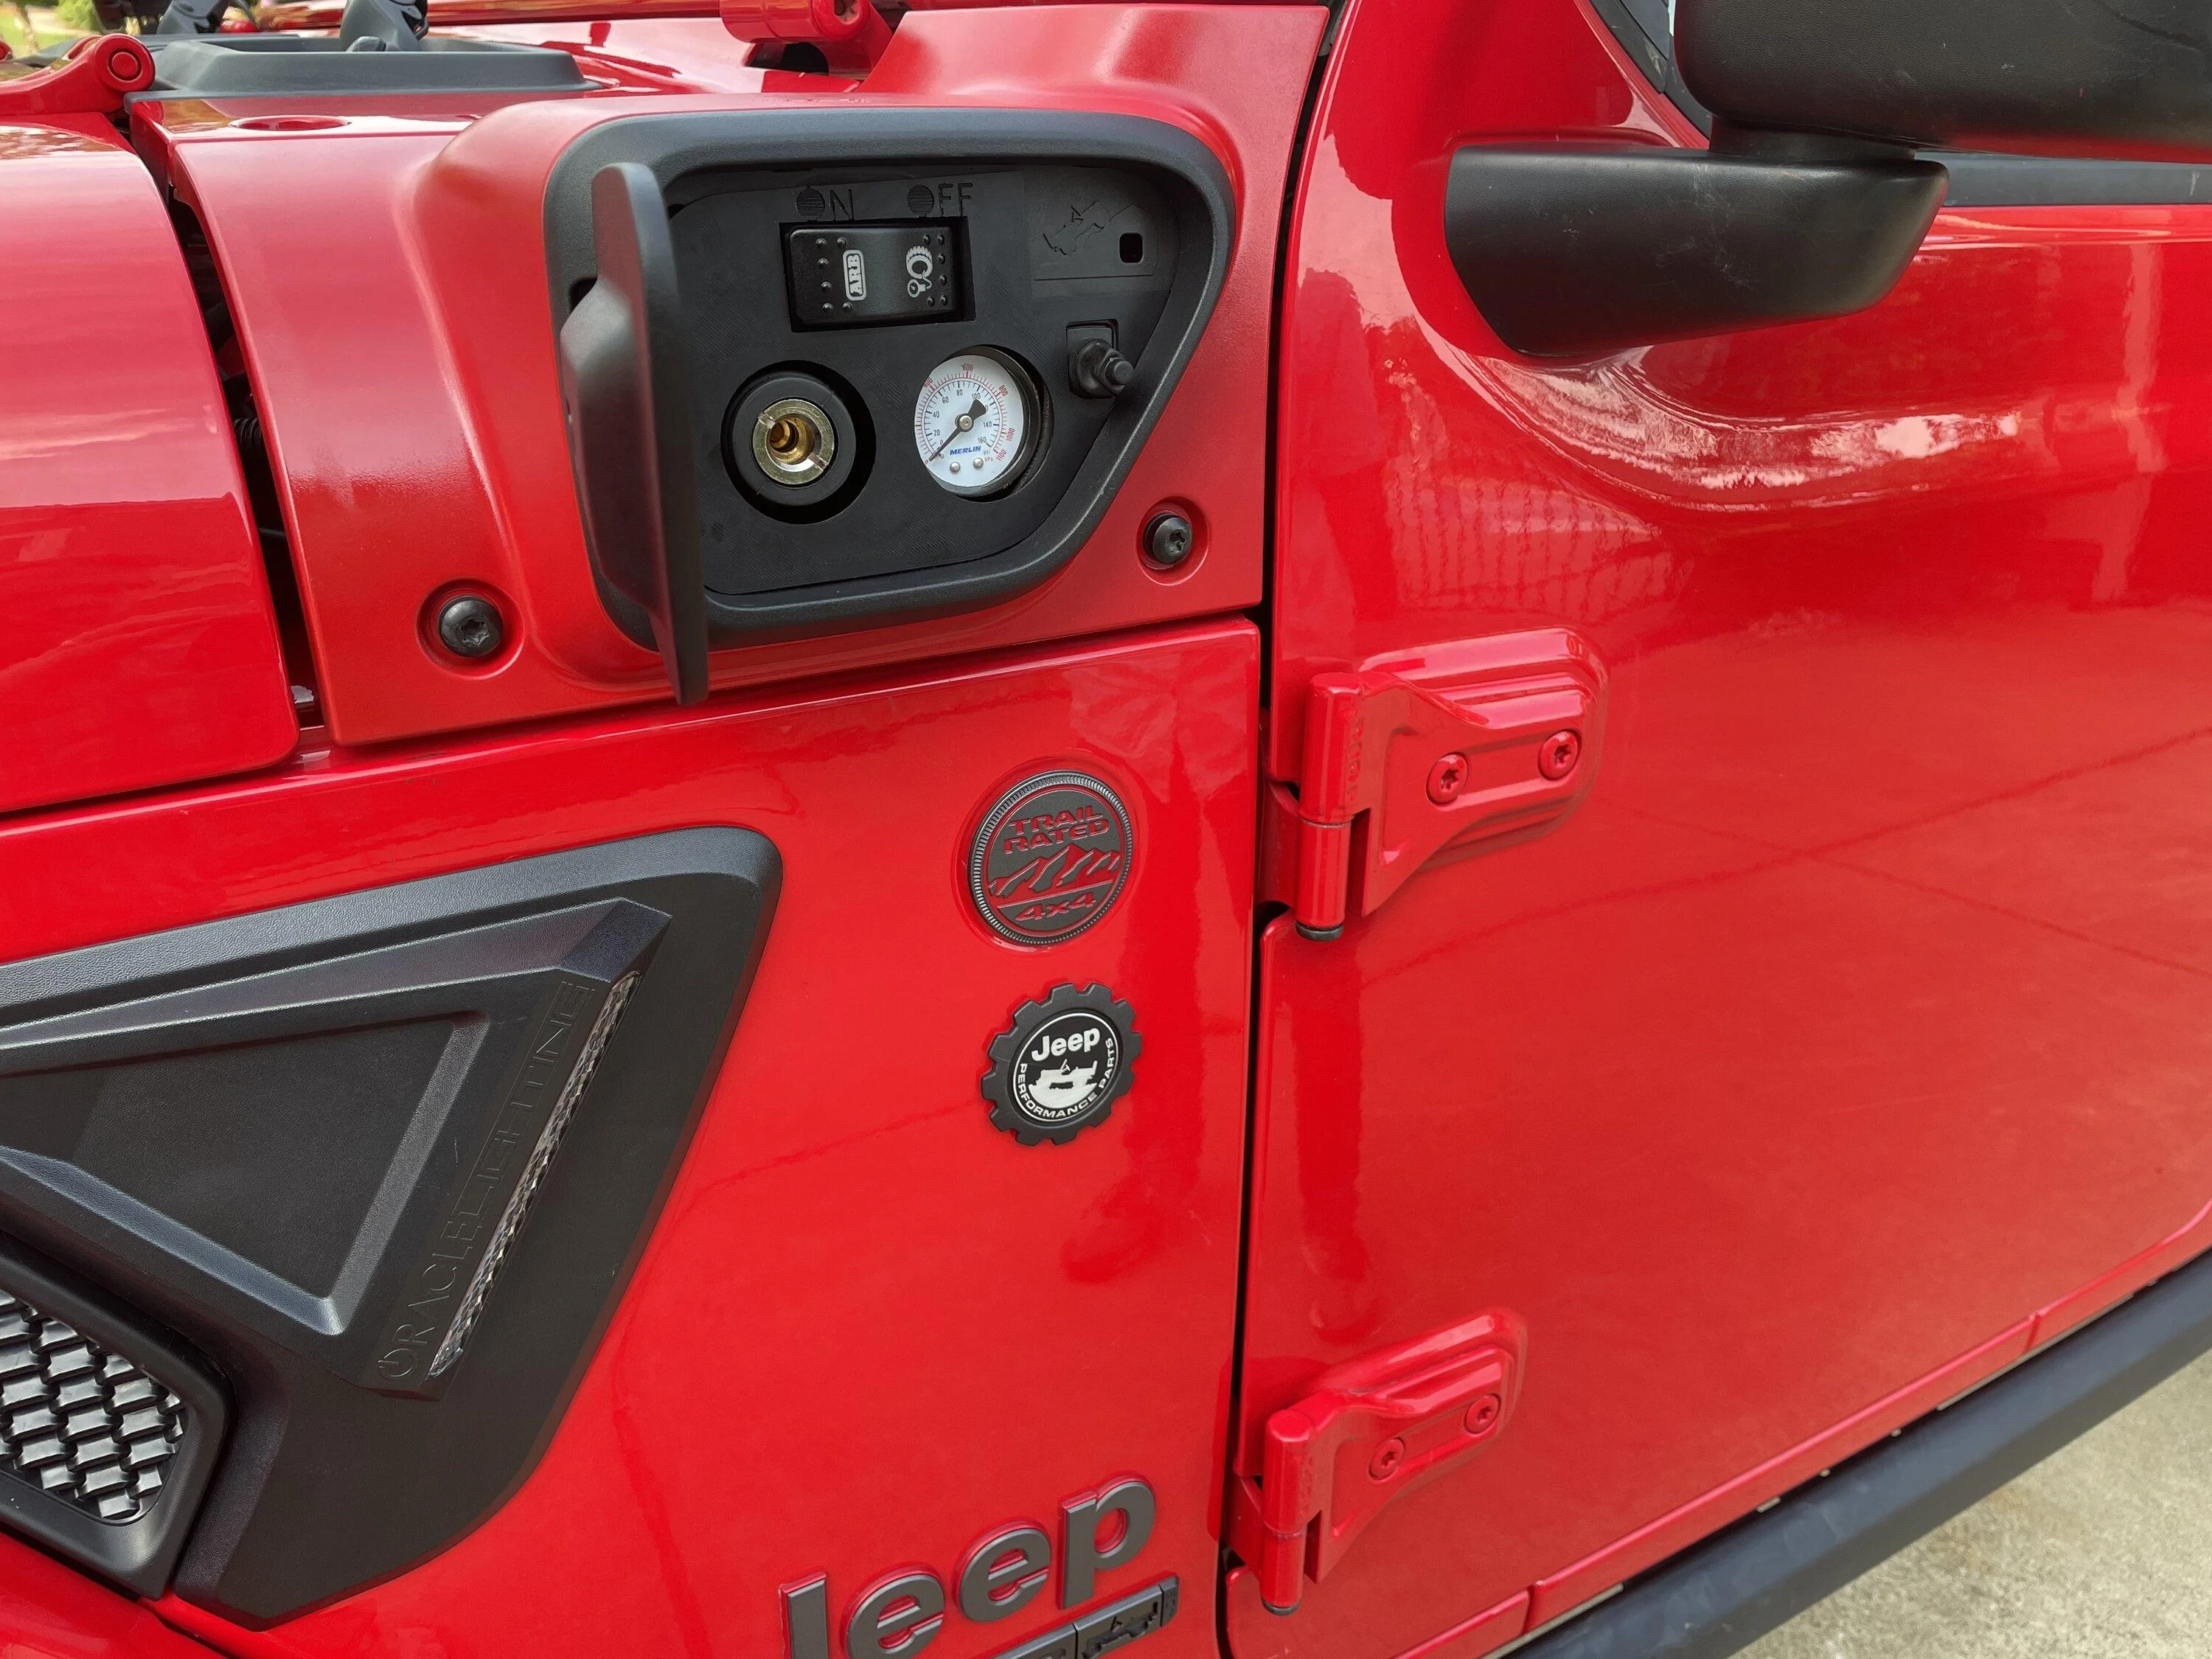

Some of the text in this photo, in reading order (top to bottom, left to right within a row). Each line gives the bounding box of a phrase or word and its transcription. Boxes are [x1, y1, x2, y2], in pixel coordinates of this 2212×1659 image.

[846, 254, 863, 296] ARB
[950, 445, 981, 456] MERLIN
[1006, 428, 1015, 442] 1000
[996, 449, 1007, 461] 1100
[1004, 819, 1110, 855] RATED
[1009, 804, 1102, 836] TRAIL
[1031, 1027, 1100, 1062] Jeep
[1018, 1037, 1116, 1118] PERFORMANCE PARTS
[377, 1220, 483, 1380] ORACLE
